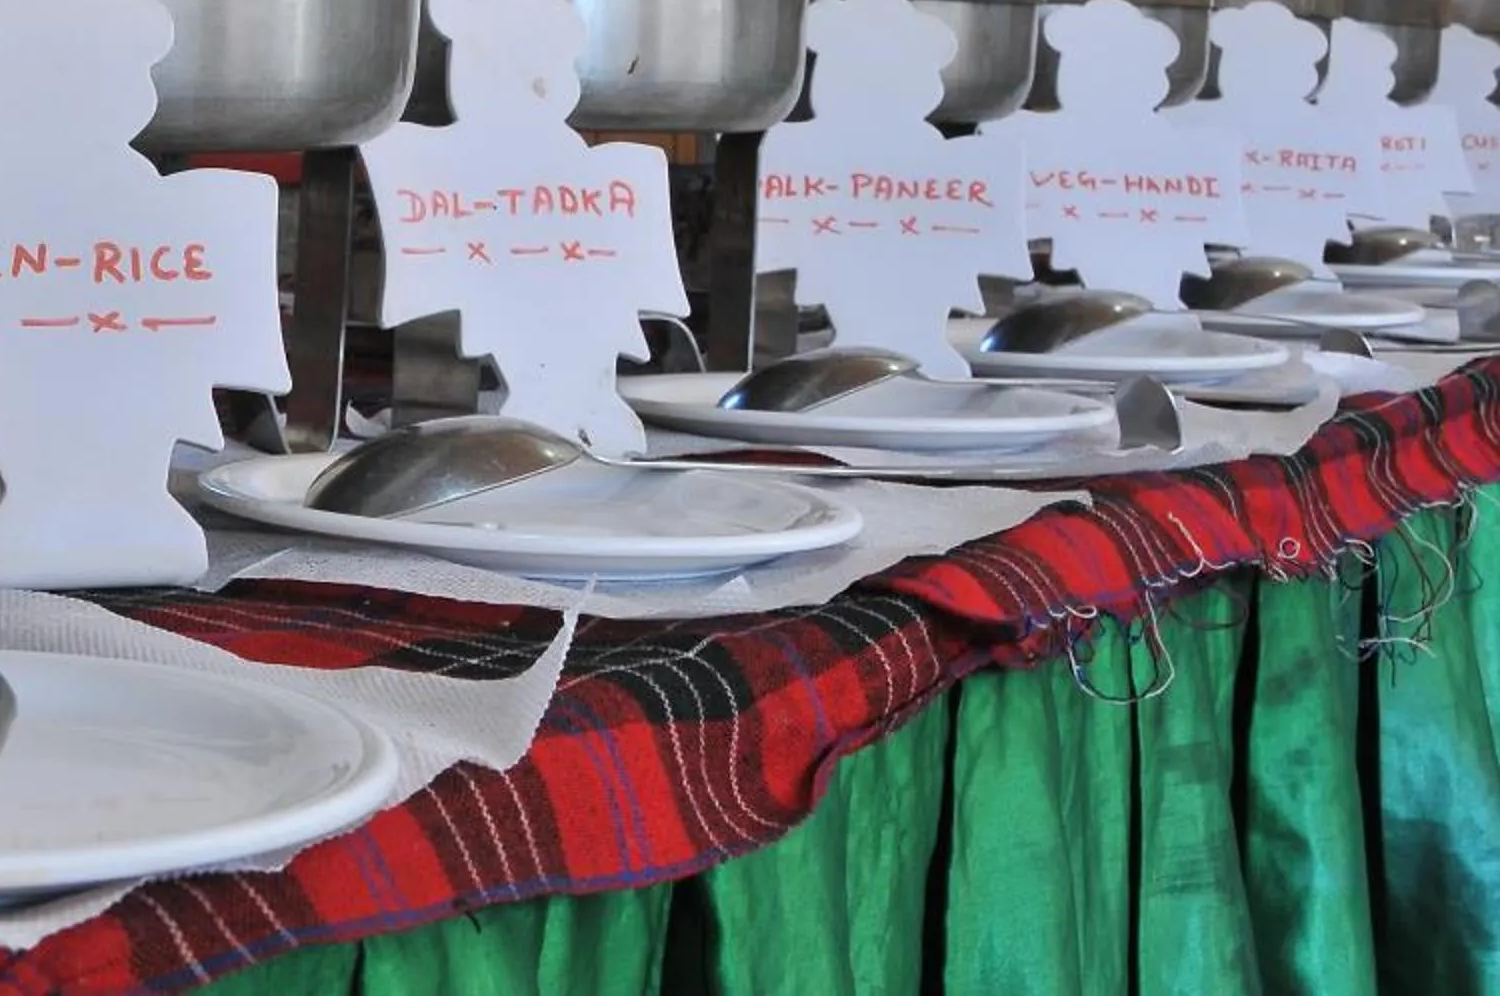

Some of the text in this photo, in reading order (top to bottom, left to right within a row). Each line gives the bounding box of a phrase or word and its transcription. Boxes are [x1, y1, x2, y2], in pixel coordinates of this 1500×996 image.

[396, 180, 637, 223] DAL-TADKA
[757, 172, 996, 208] ALK-PANEER
[1029, 170, 1221, 199] VEG-HANDI
